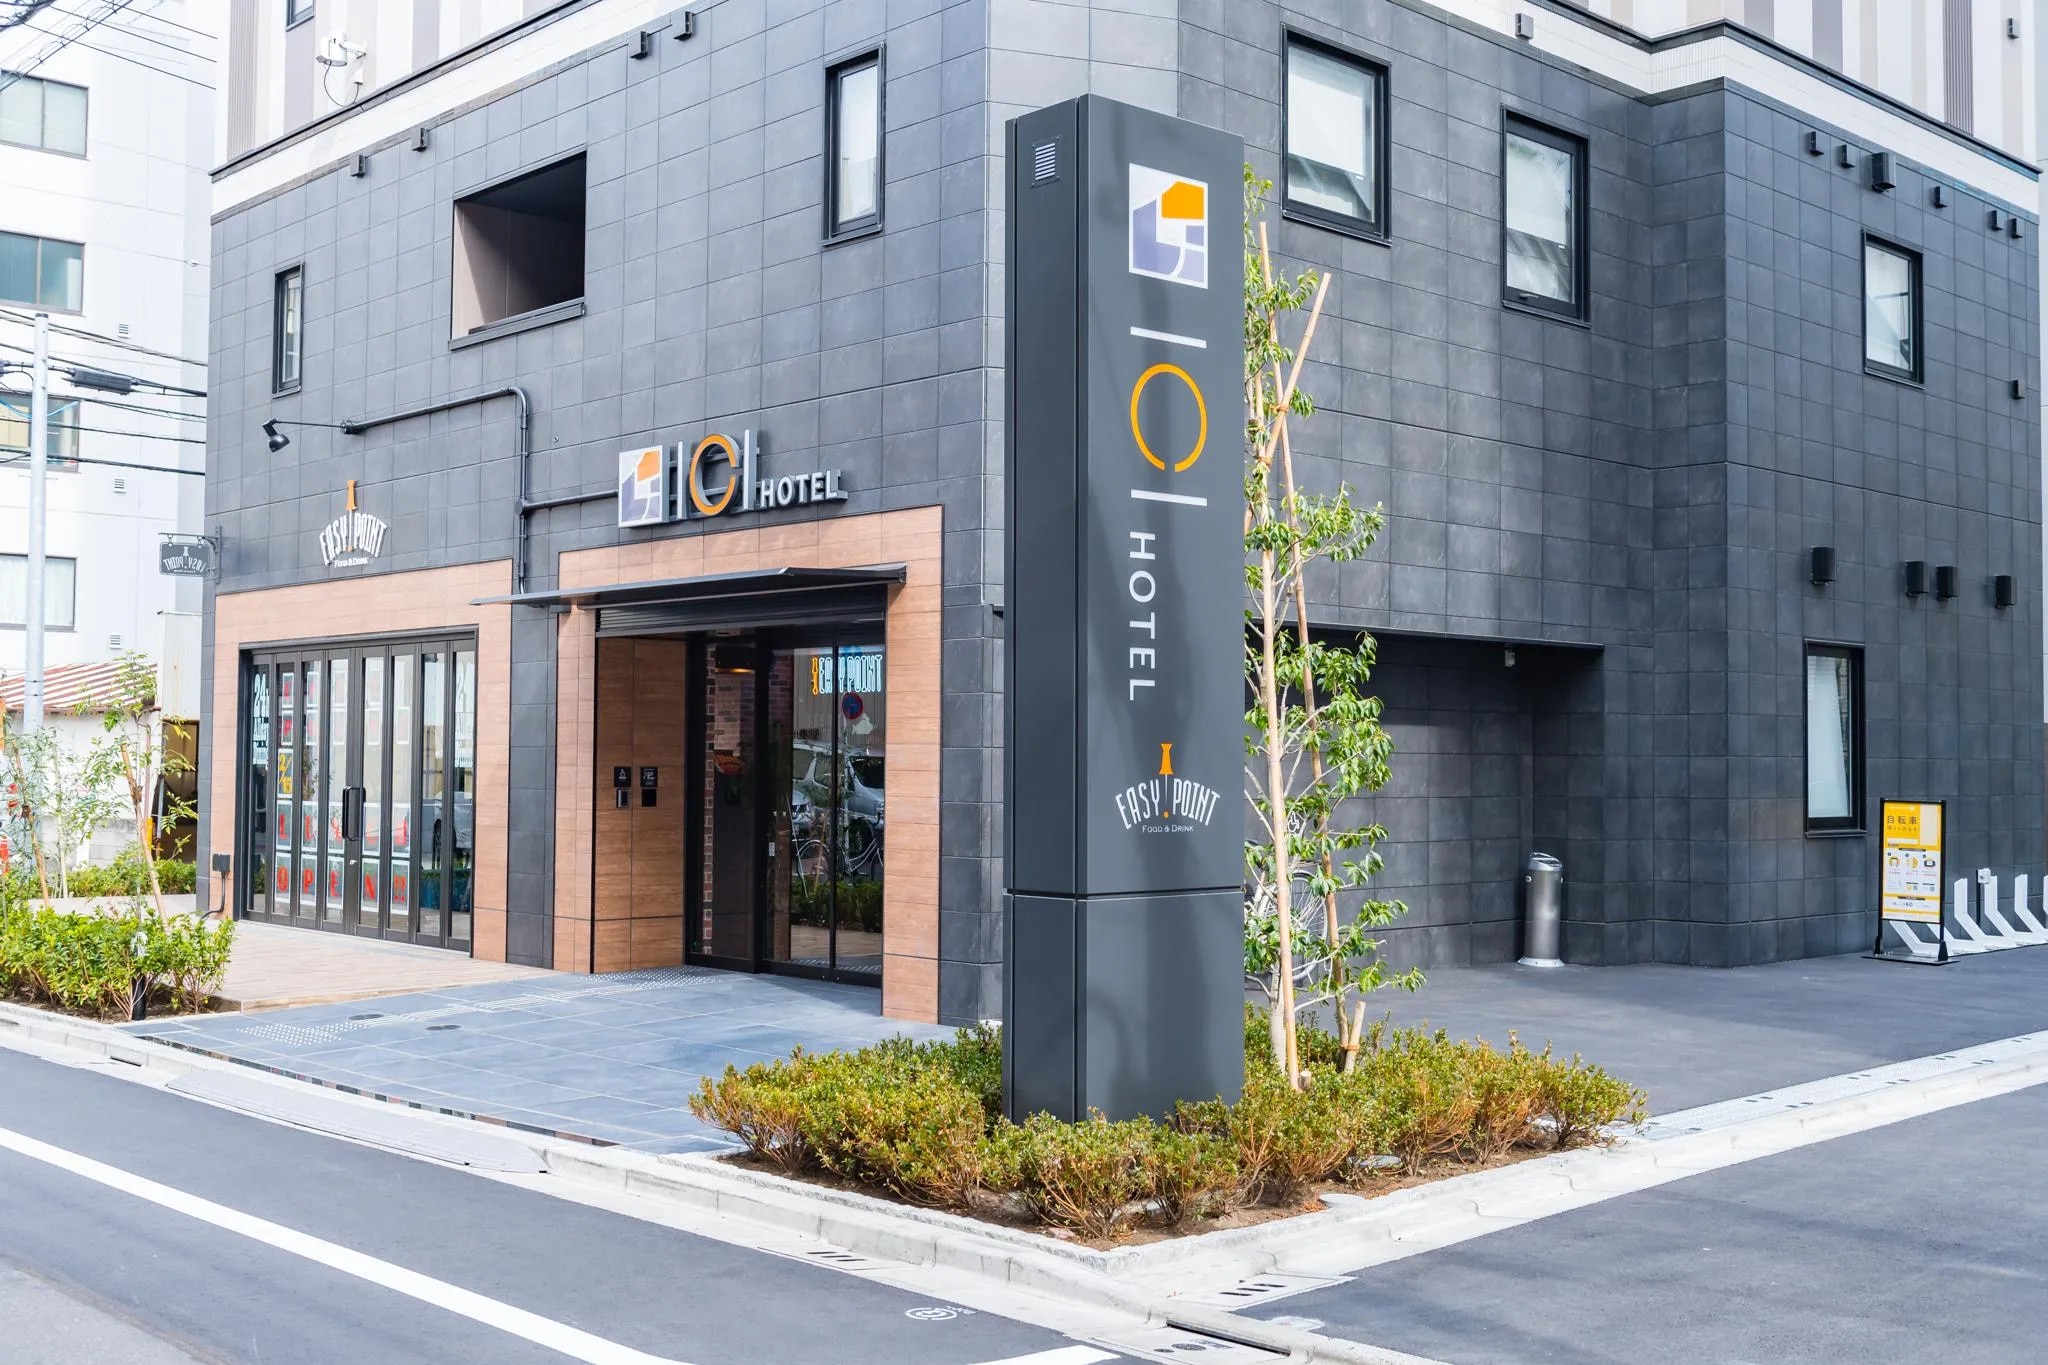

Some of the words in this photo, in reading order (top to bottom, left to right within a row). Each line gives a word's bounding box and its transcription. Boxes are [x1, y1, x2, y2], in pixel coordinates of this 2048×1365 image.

[760, 469, 842, 509] HOTEL
[319, 514, 348, 566] EASY
[353, 511, 388, 558] POINT
[1128, 530, 1157, 702] HOTEL
[818, 656, 846, 694] EAY
[846, 654, 883, 694] POINT
[1115, 778, 1161, 831] EASY
[1172, 777, 1221, 827] POINT
[1164, 824, 1170, 832] &
